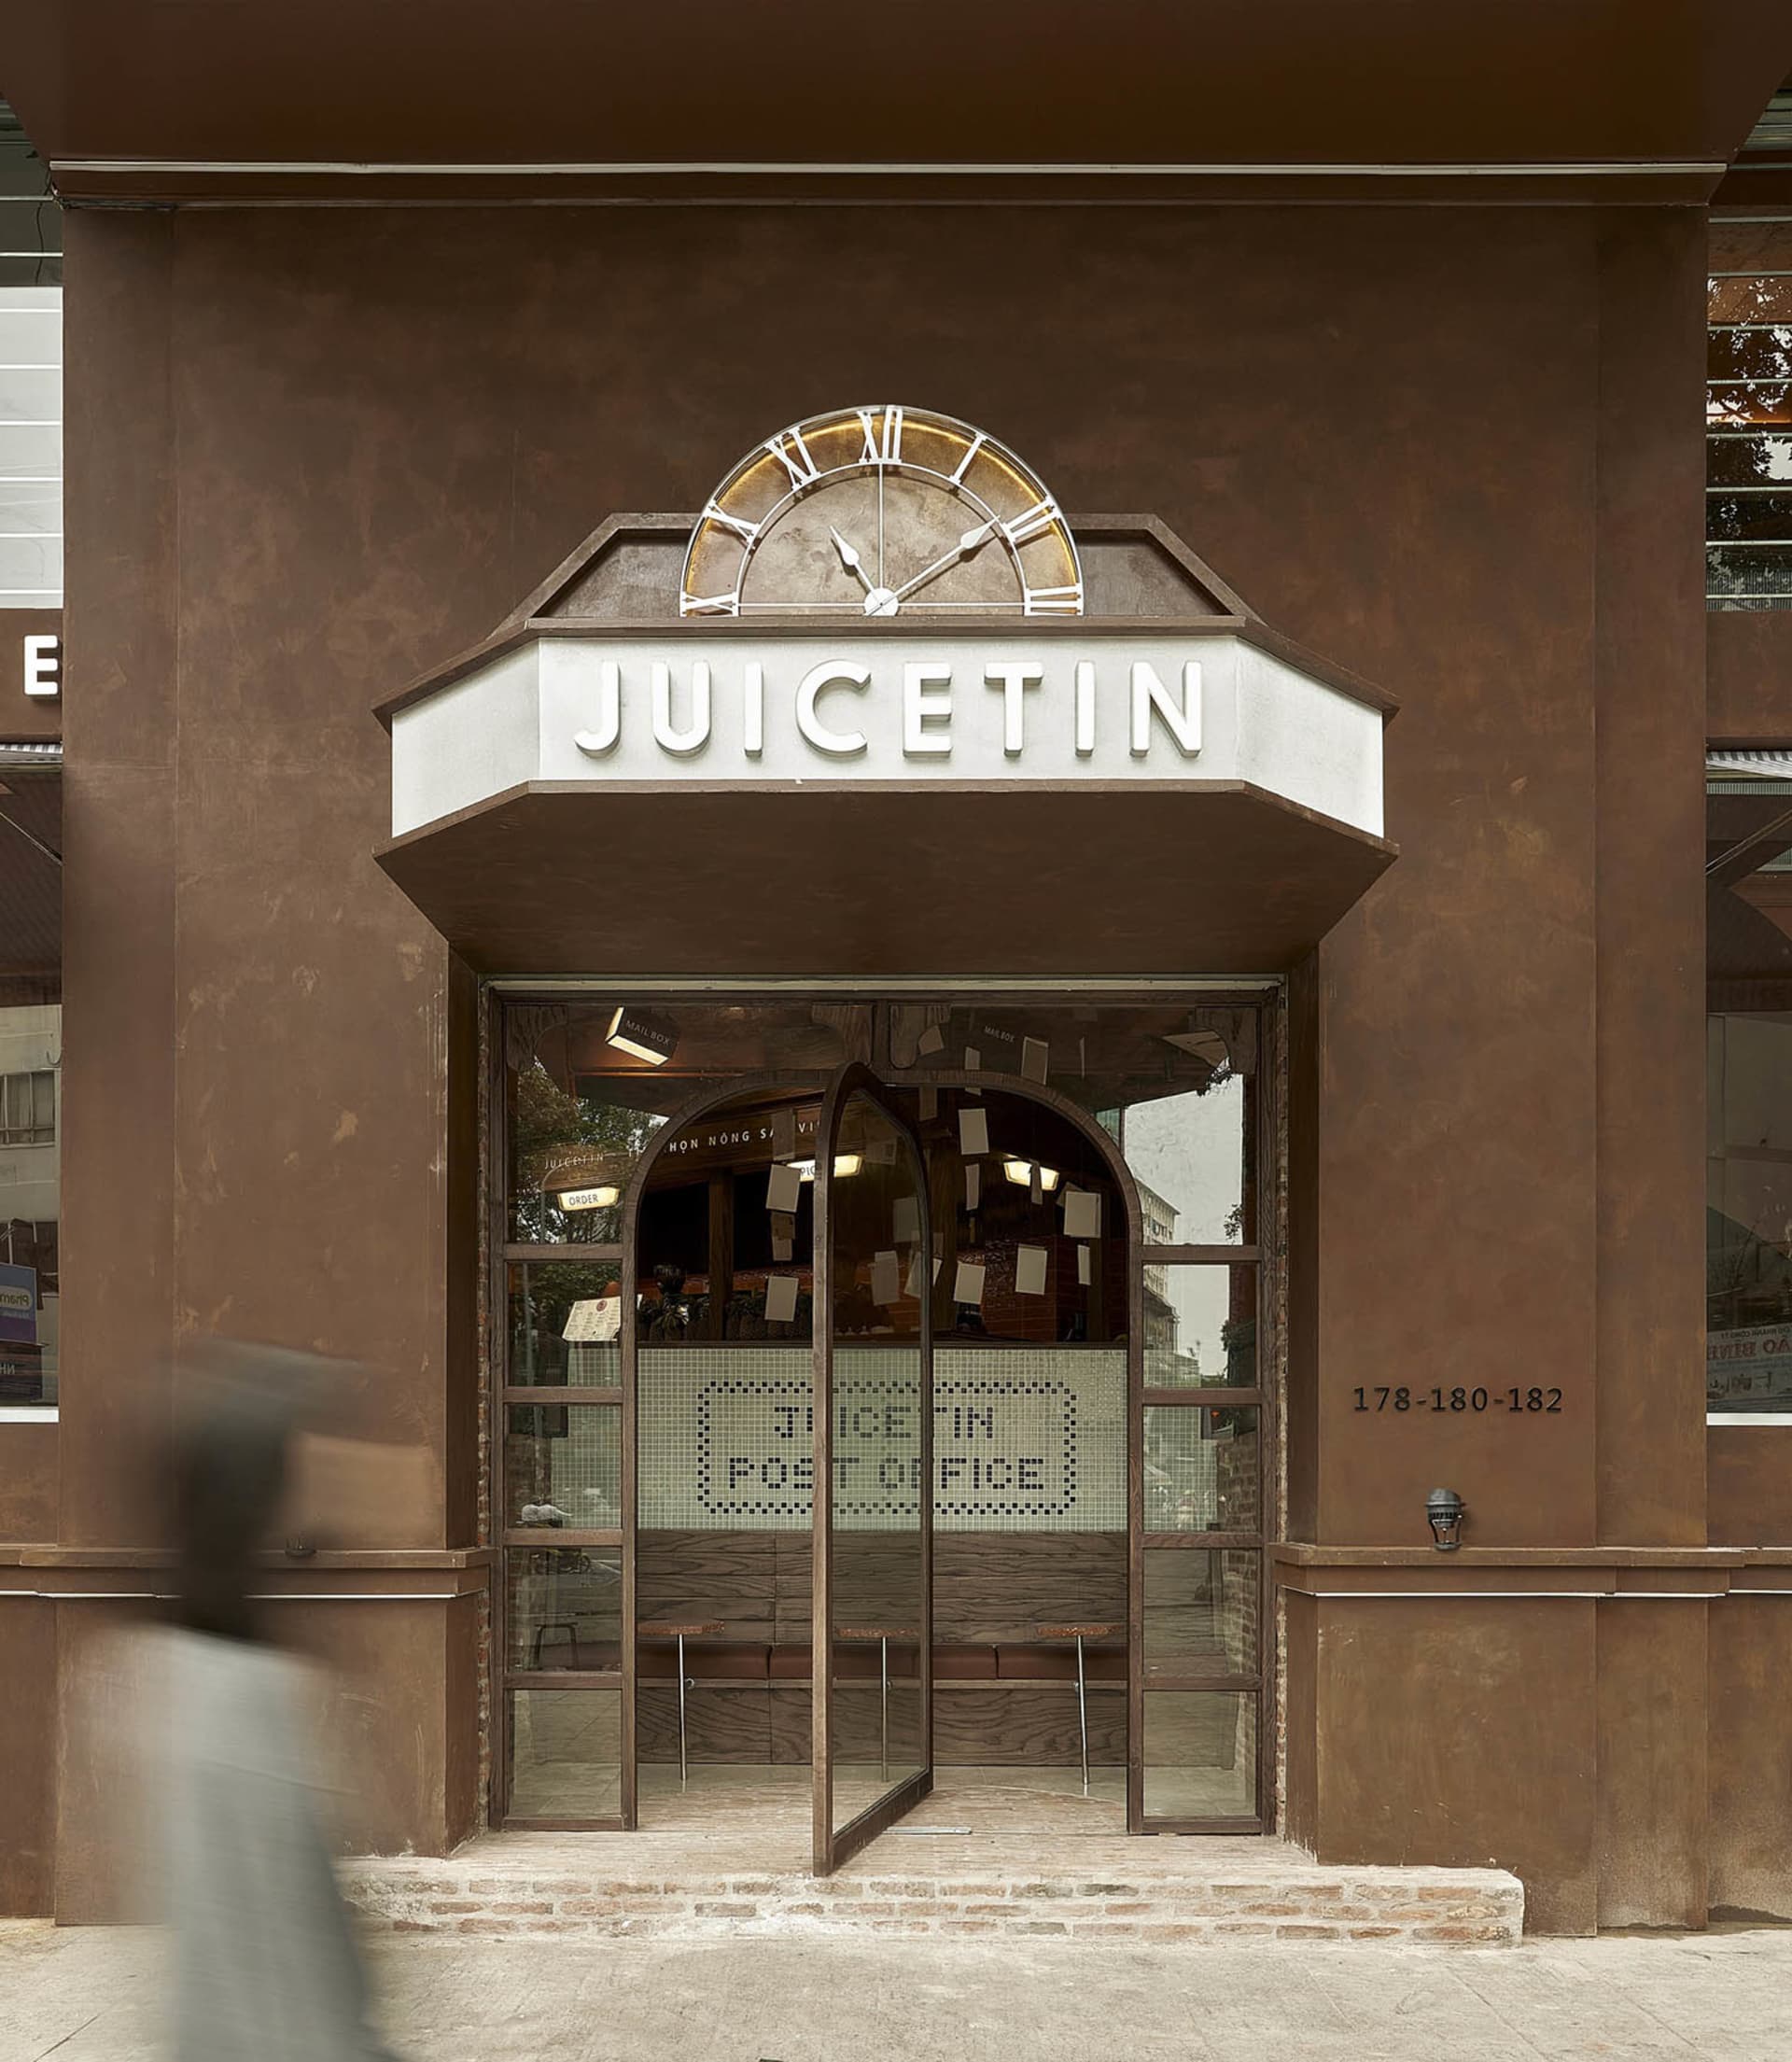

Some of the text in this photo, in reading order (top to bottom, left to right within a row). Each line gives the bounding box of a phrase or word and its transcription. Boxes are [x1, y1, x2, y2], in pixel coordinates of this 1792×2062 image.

[855, 404, 905, 466] XII
[763, 425, 820, 491] XI
[574, 659, 1204, 758] JUICETIN
[544, 1152, 604, 1170] JUICETIN
[664, 1138, 699, 1155] HỌN
[708, 1129, 750, 1146] NÔNG
[568, 1194, 599, 1206] ORDER
[1353, 1386, 1563, 1413] 178-180-182
[775, 1406, 993, 1438] JICEIN
[729, 1457, 860, 1490] POST
